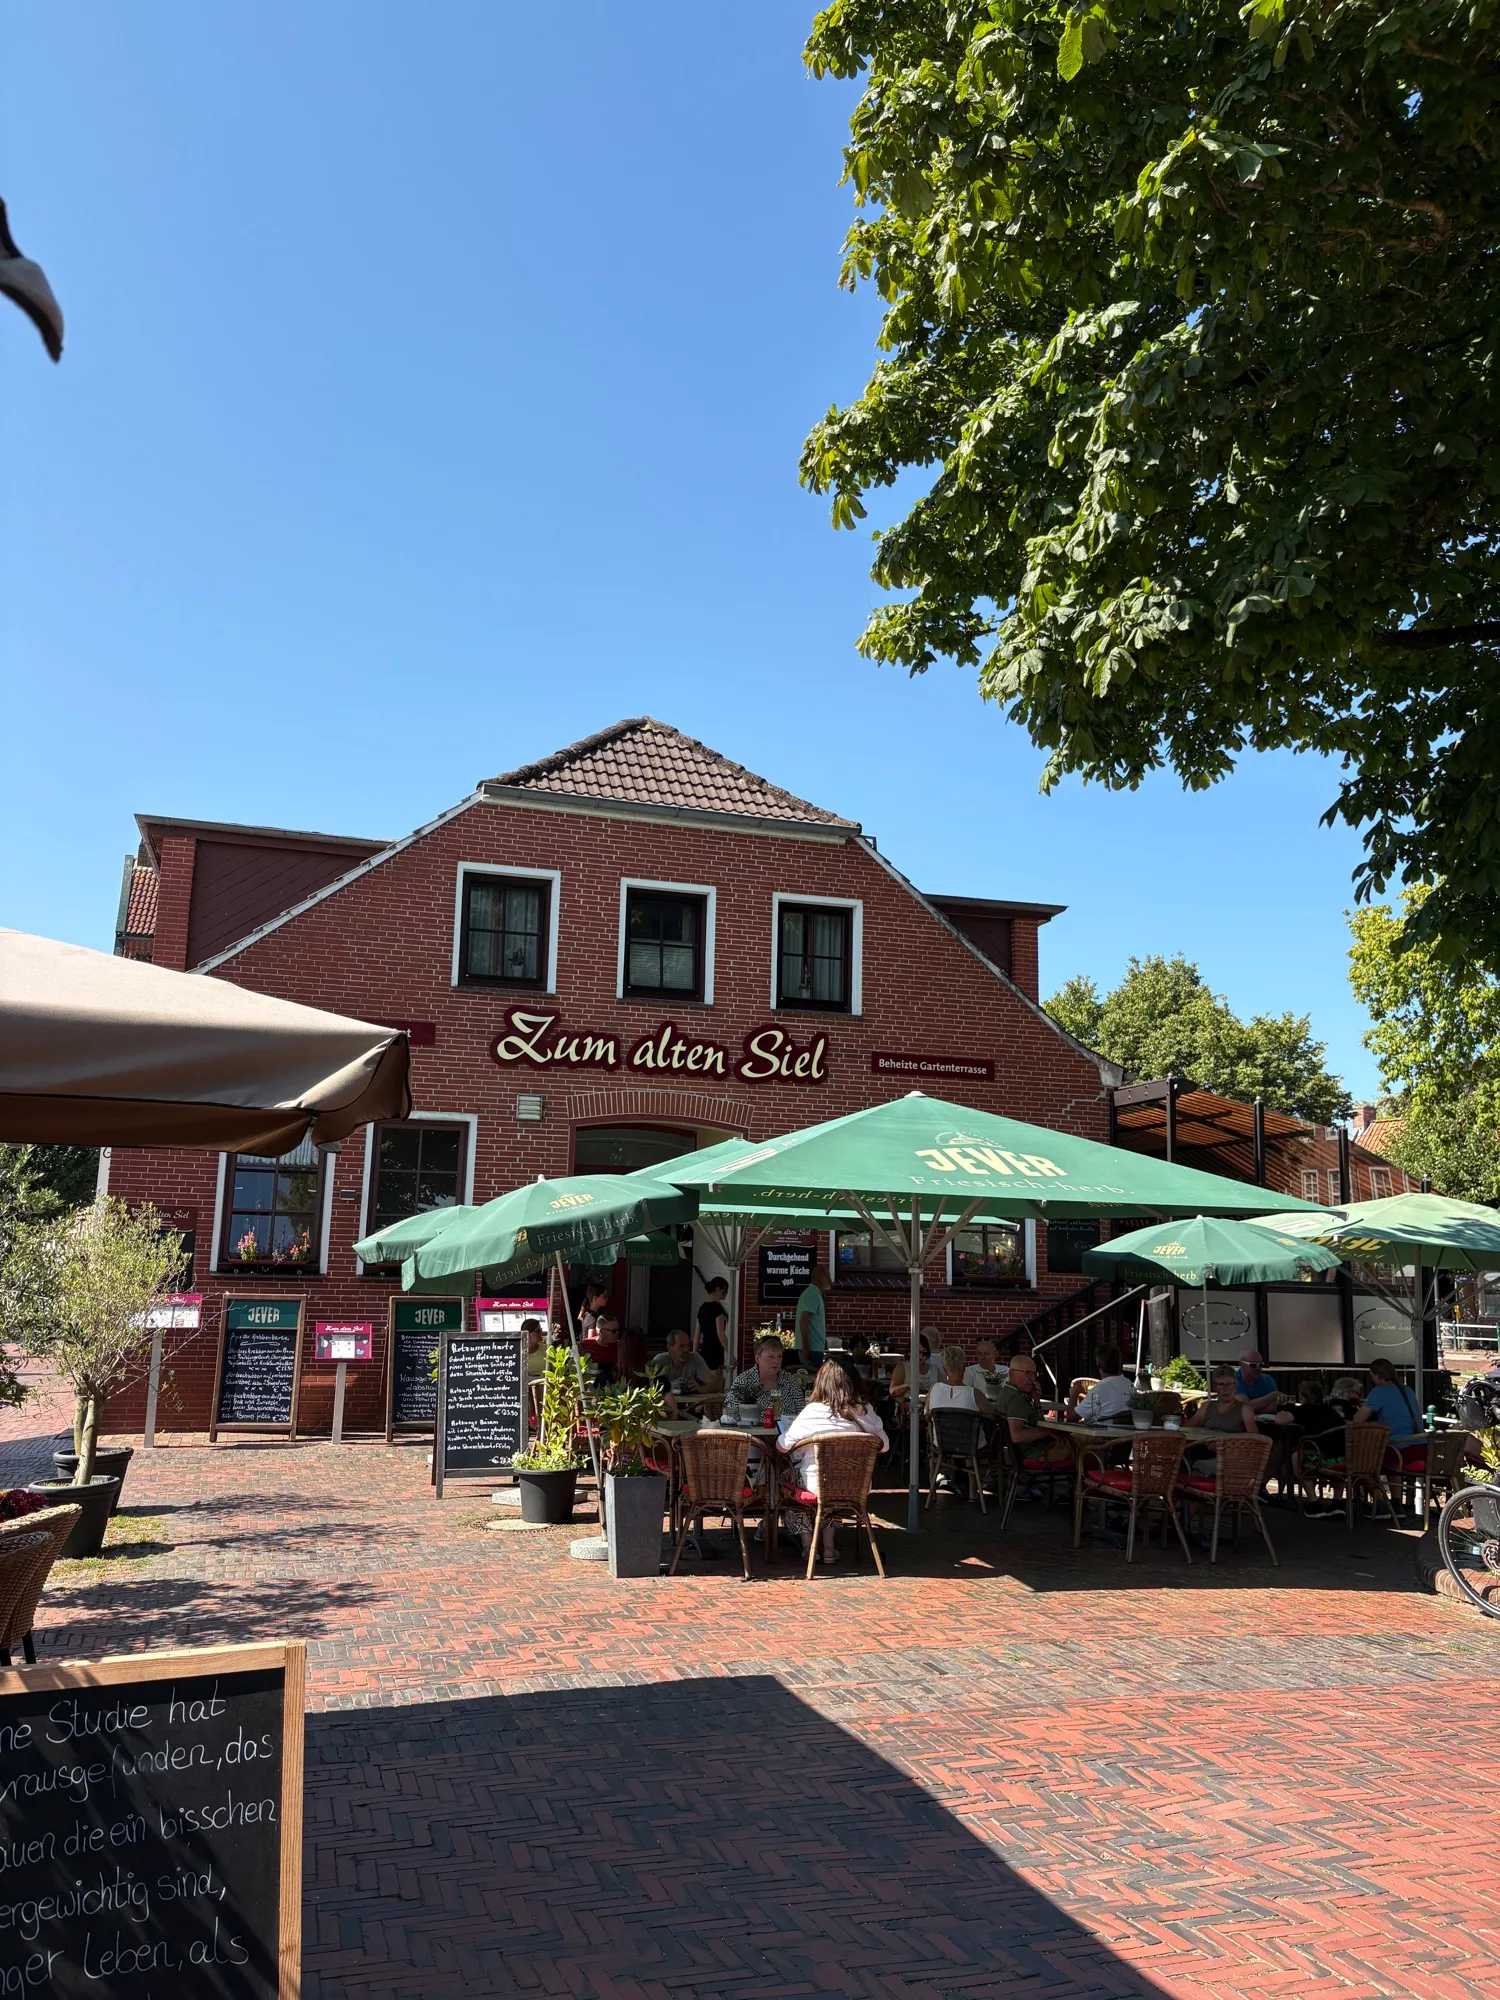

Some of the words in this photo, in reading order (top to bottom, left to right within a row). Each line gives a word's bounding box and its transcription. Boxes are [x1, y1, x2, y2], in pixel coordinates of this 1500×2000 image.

[497, 1011, 616, 1065] Zum
[633, 1026, 726, 1074] alten
[741, 1030, 825, 1079] Siel
[879, 1058, 918, 1070] Beheizte
[919, 1061, 987, 1075] Gartenterrasse
[915, 1147, 1068, 1177] JEVER
[549, 1193, 594, 1209] JEVER
[767, 1251, 809, 1262] Durchgehend
[1152, 1245, 1187, 1255] JEVER
[766, 1267, 789, 1275] warme
[789, 1265, 810, 1276] Küche
[248, 1306, 280, 1324] JEVER
[415, 1308, 445, 1325] JEVER
[45, 1699, 152, 1744] Studie
[169, 1679, 226, 1724] hat
[64, 1819, 105, 1856] die
[110, 1813, 146, 1847] ein
[160, 1790, 278, 1840] bisschen
[158, 1864, 227, 1901] sind,
[189, 1916, 250, 1965] als
